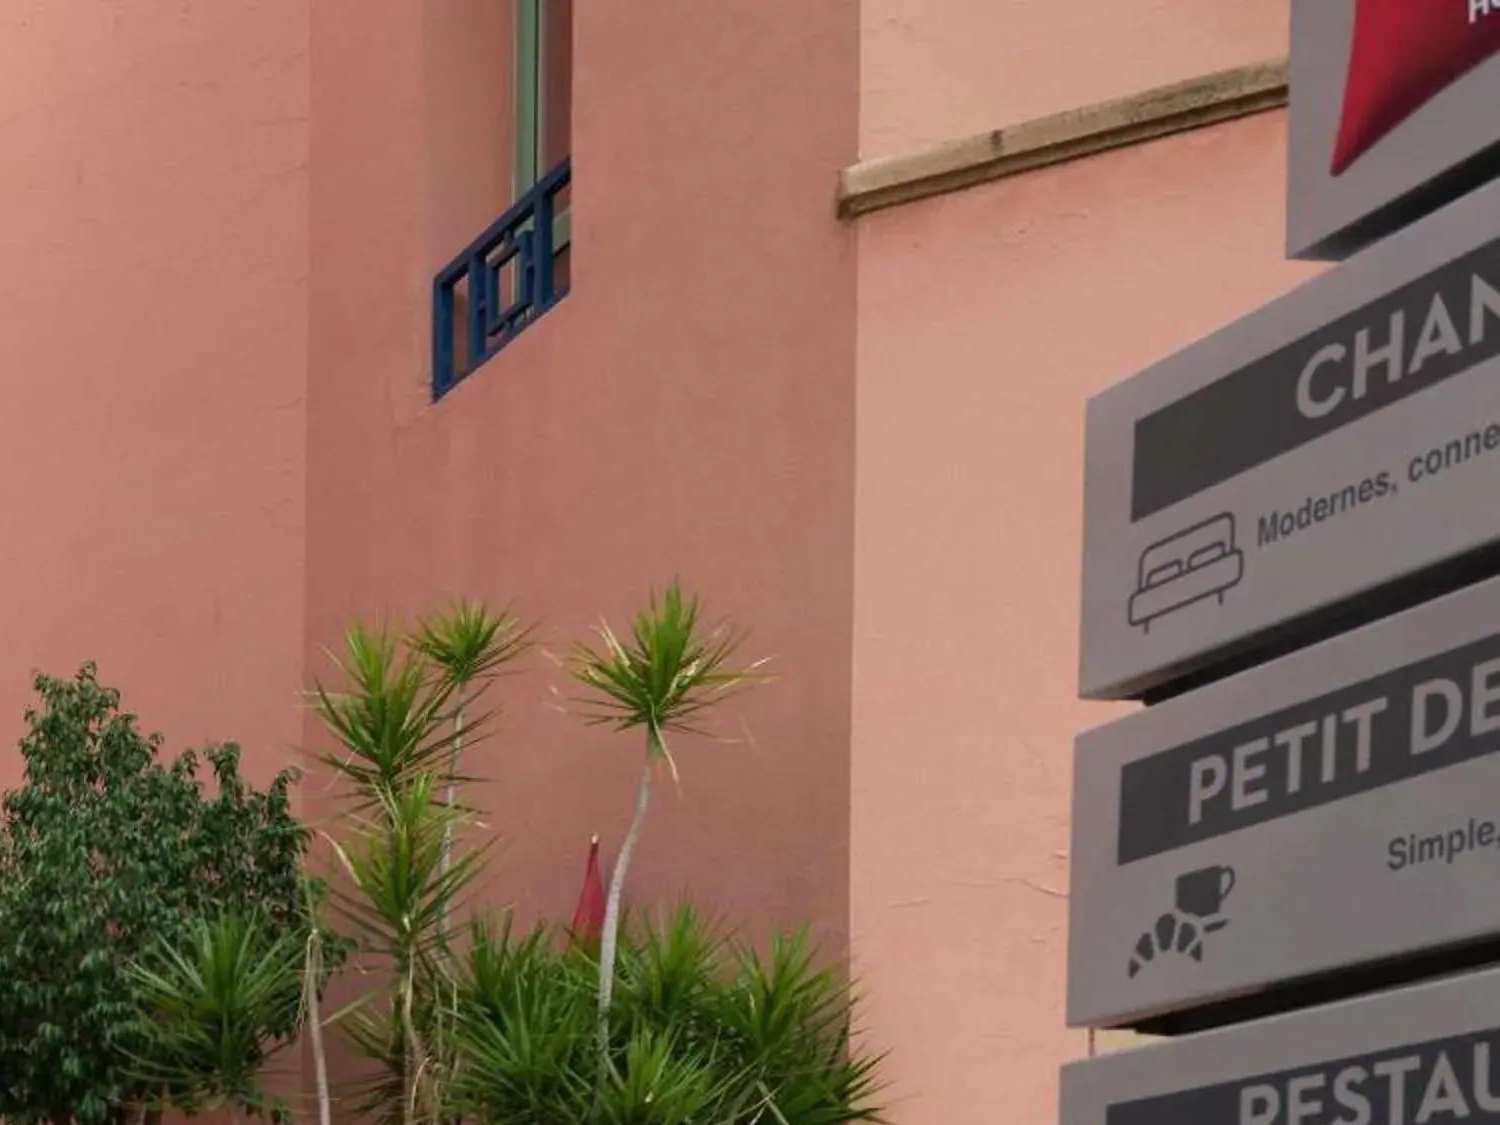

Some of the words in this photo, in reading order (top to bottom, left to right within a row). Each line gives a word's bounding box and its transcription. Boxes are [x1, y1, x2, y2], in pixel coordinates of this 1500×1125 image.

[1257, 470, 1398, 549] Modernes,
[1408, 423, 1500, 482] conne
[1189, 697, 1388, 824] PETIT
[1411, 656, 1500, 755] DE
